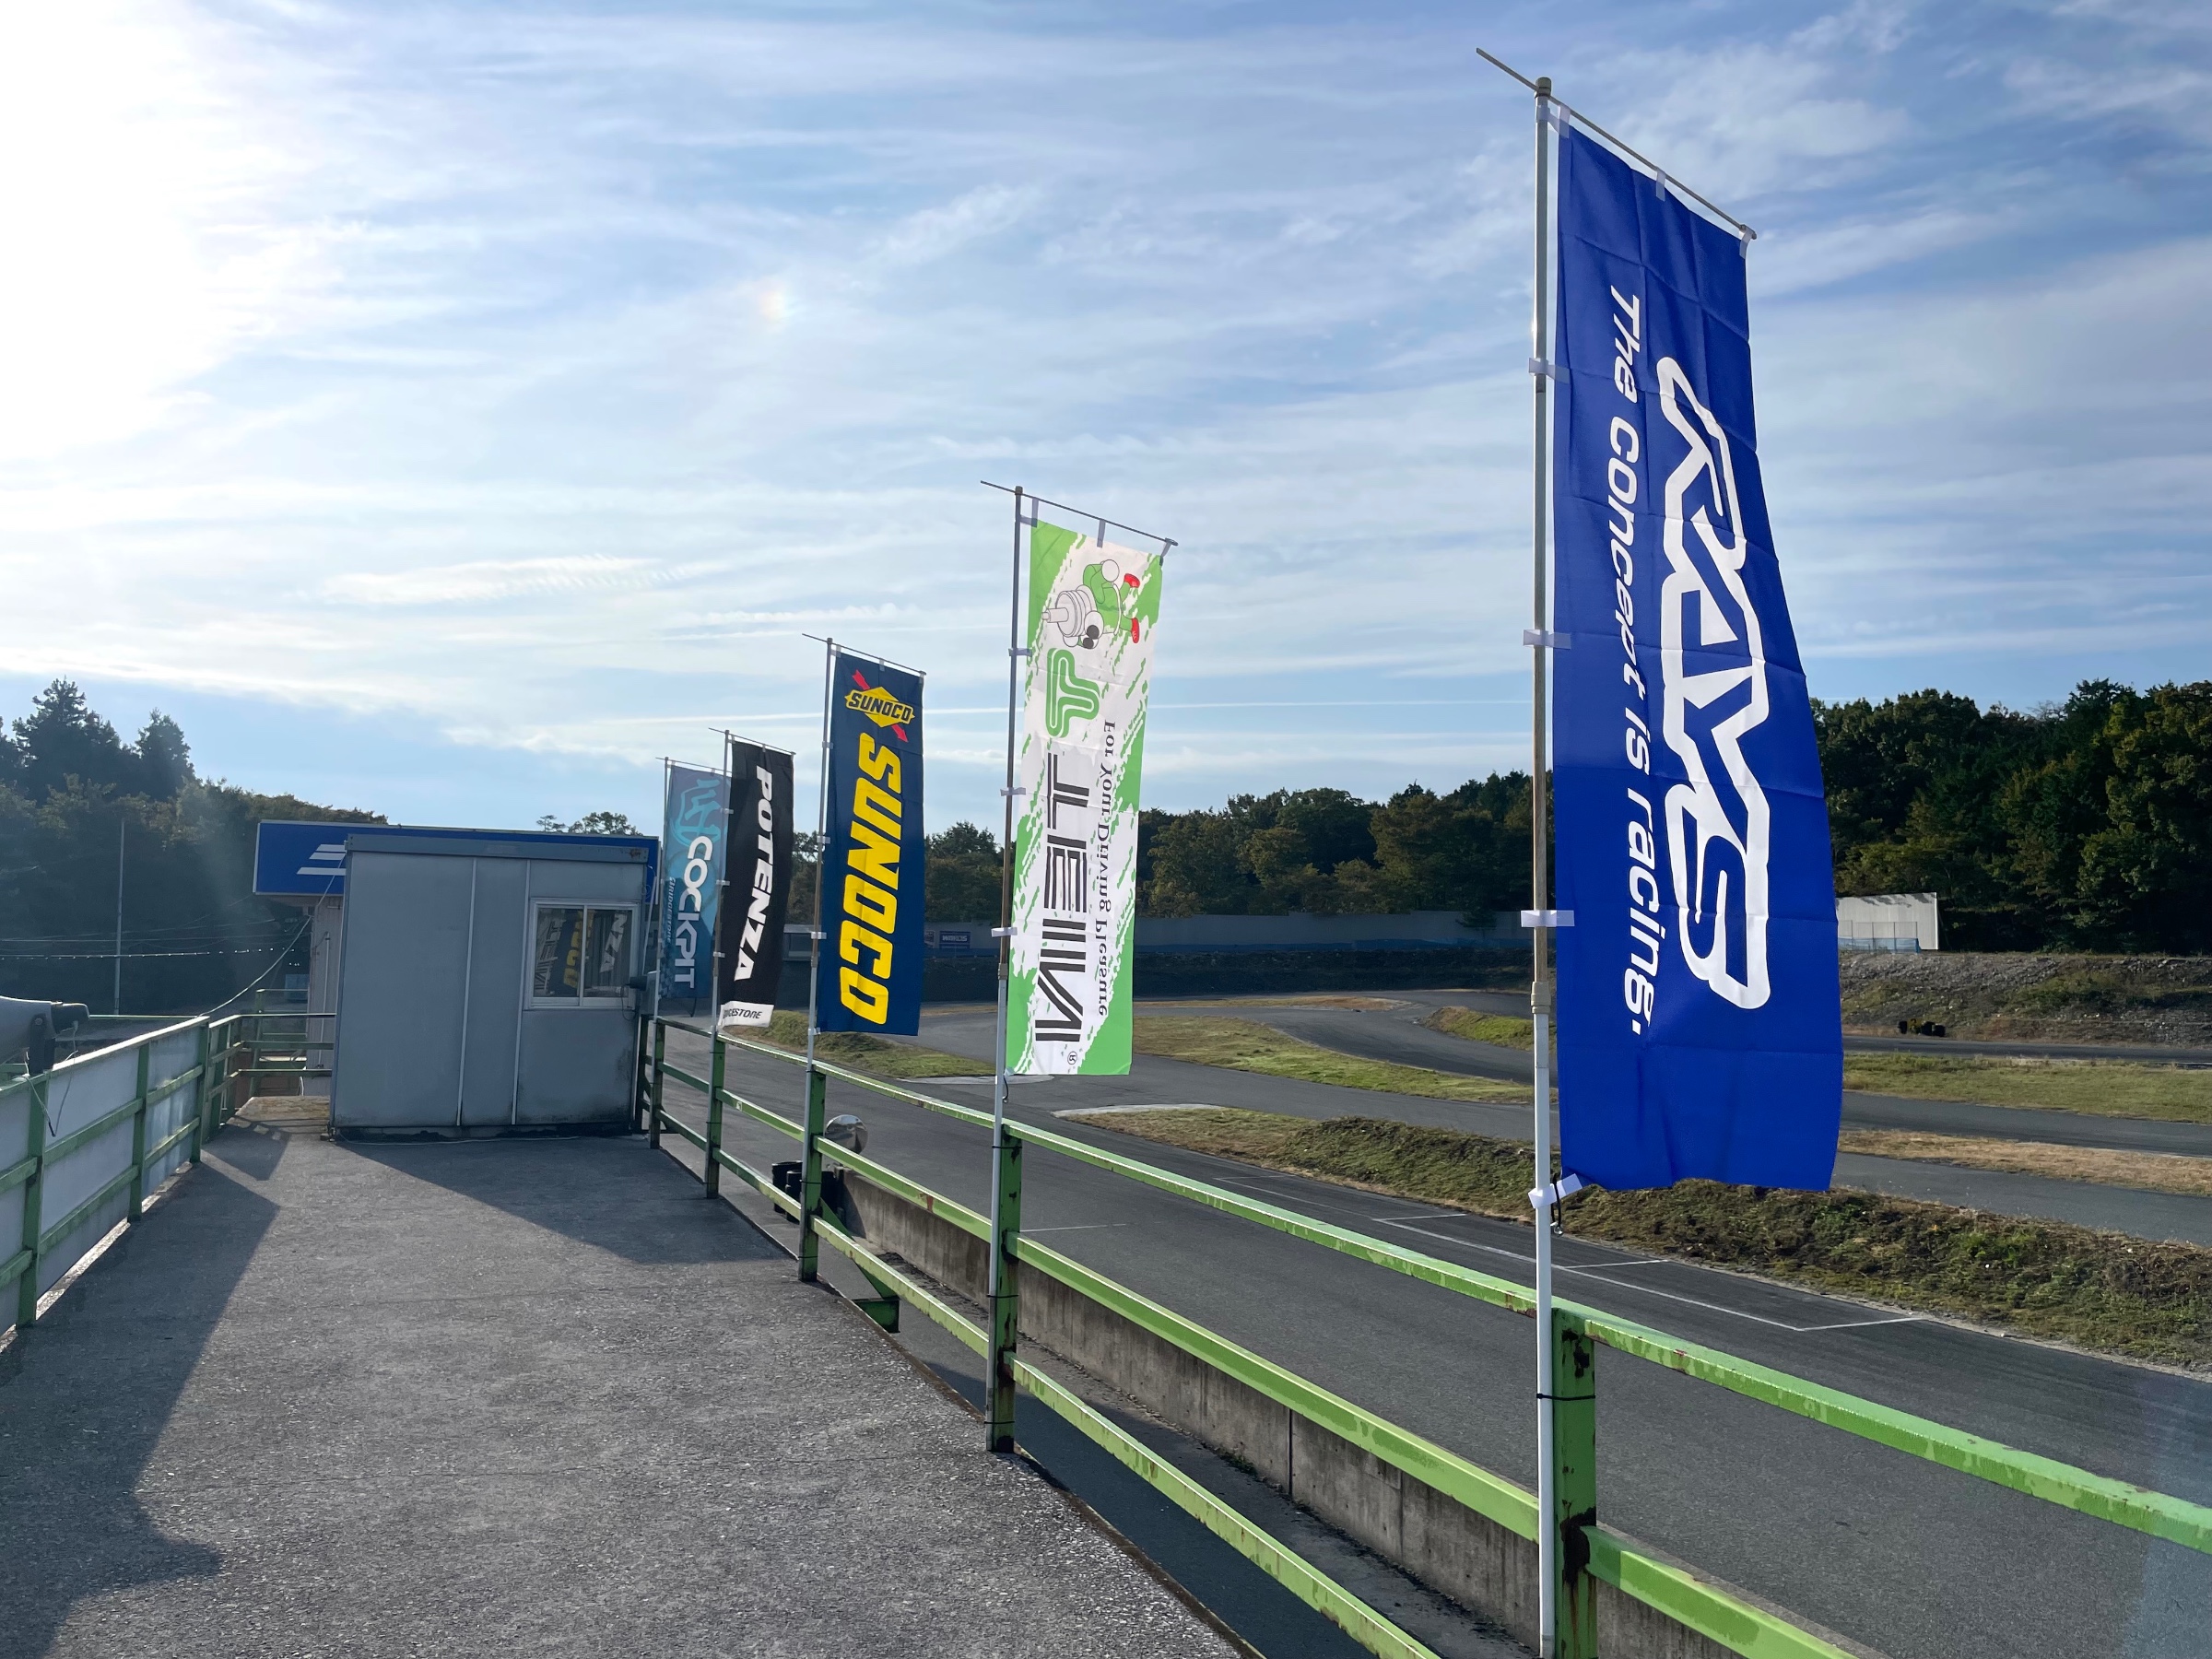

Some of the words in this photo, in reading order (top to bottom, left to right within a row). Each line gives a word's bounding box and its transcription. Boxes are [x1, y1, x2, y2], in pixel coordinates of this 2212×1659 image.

[1610, 285, 1641, 404] The
[1608, 417, 1646, 700] concept
[848, 692, 912, 722] SUNOCO
[1625, 707, 1651, 776] is
[1656, 357, 1771, 1009] RAYS
[675, 835, 713, 989] COCKPIT
[734, 765, 774, 982] POTENZA
[839, 732, 902, 1025] SUNOCO
[1624, 788, 1665, 1036] racing.
